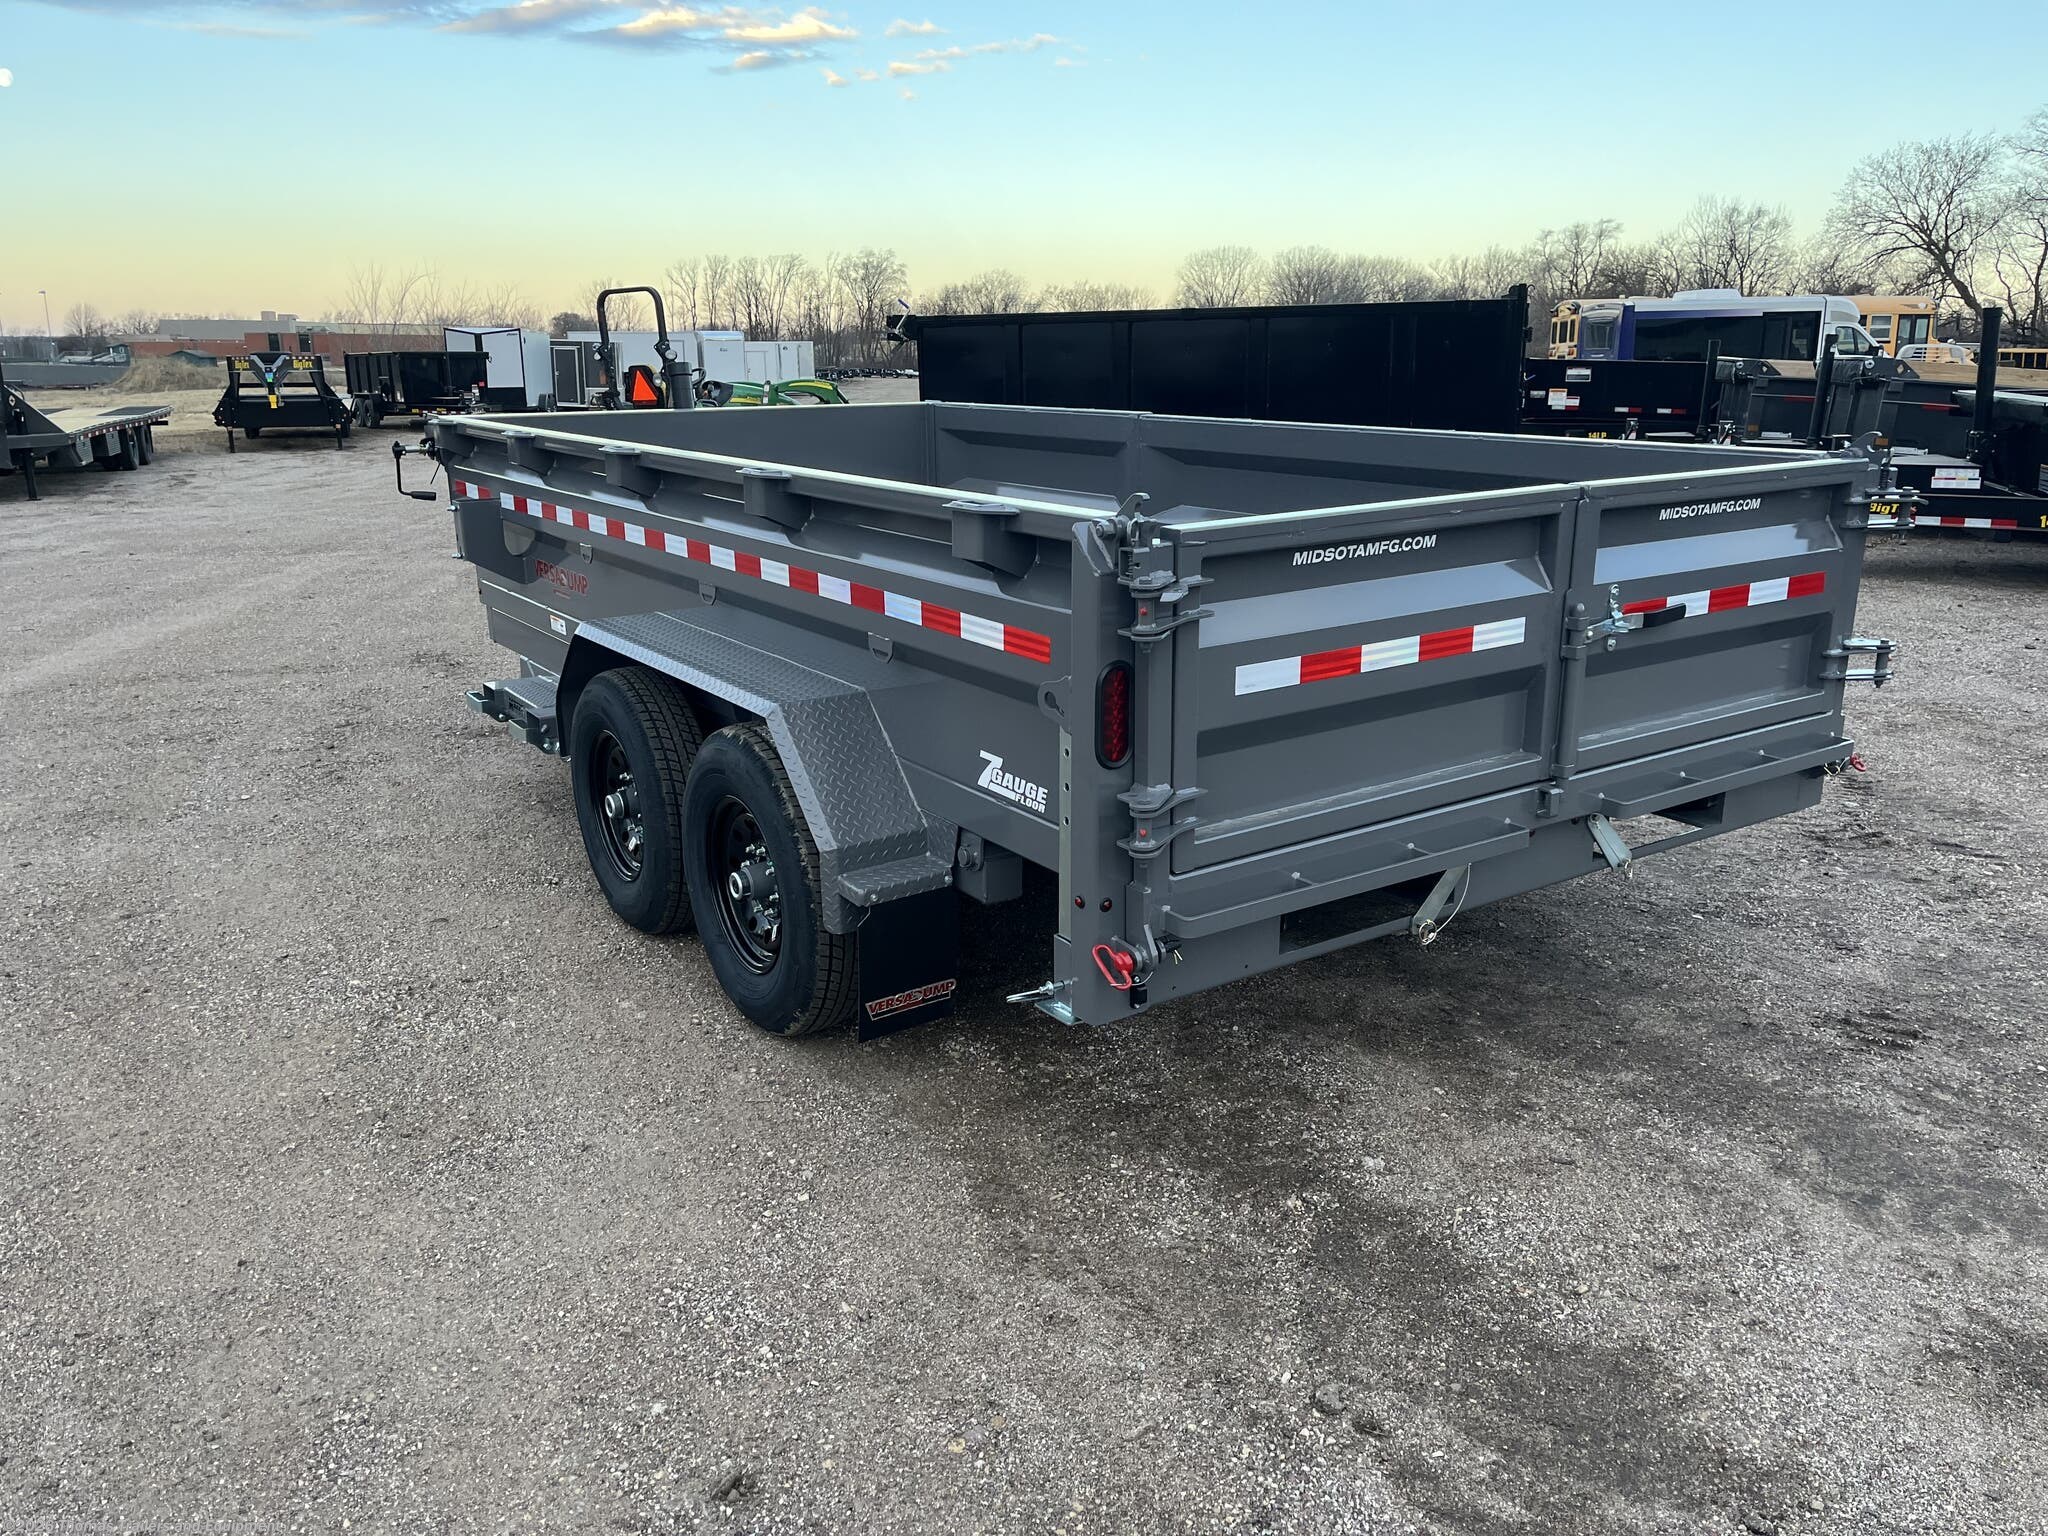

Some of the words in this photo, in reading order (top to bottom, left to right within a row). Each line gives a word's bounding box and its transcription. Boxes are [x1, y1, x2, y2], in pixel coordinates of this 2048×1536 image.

[1659, 498, 1761, 520] MIDSOTAMFG.COM
[1869, 502, 1900, 515] BigT
[1292, 534, 1437, 566] MIDSOTAMFG.COM
[991, 768, 1048, 805] GAUGE
[1015, 793, 1046, 813] FLOOR
